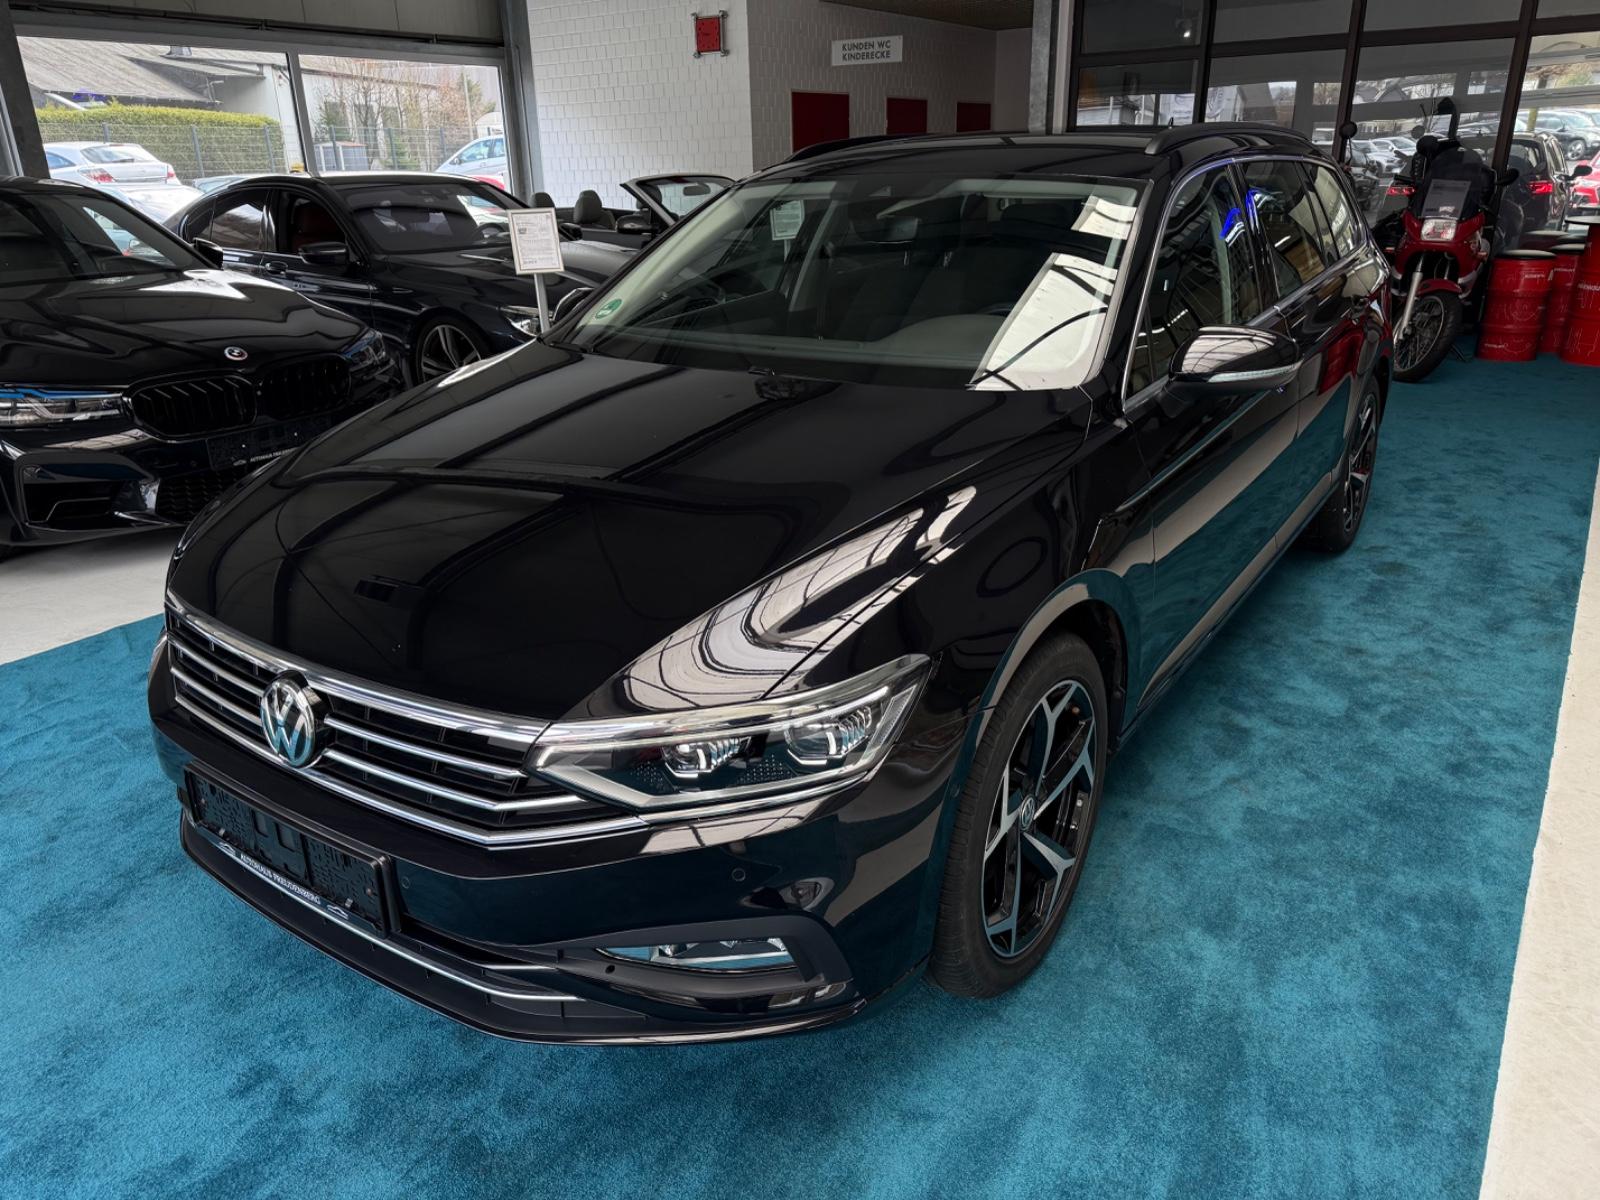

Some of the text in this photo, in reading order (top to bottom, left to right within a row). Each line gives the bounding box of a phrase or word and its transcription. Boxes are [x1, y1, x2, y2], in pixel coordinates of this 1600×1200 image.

[842, 40, 891, 51] KUNDEN WC
[842, 50, 891, 61] KINDERECKE
